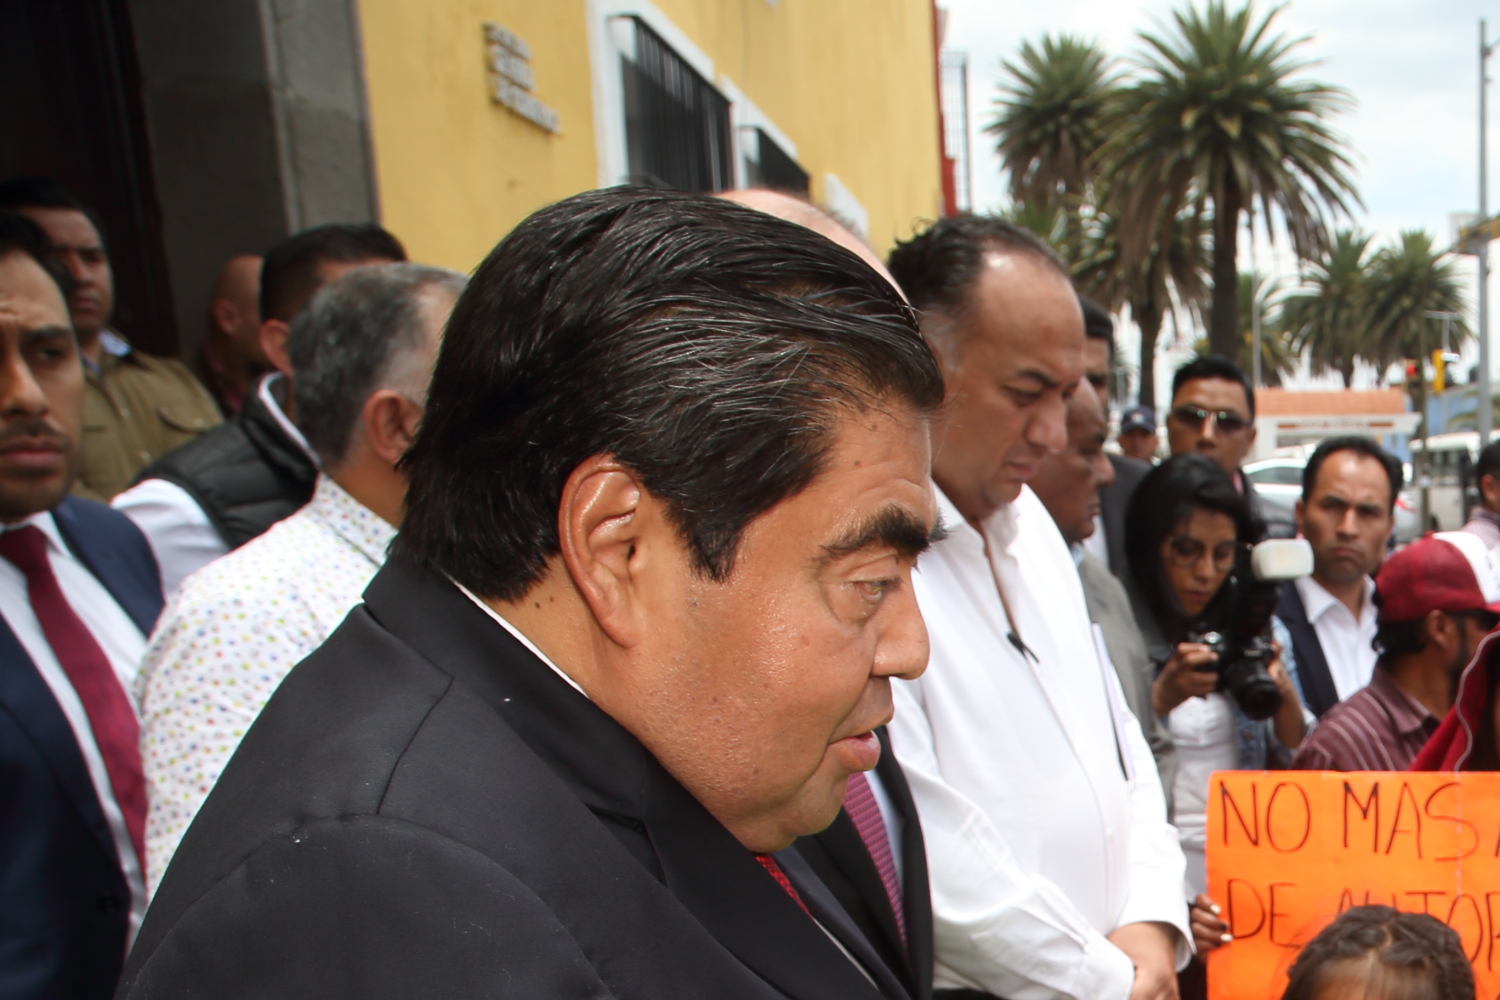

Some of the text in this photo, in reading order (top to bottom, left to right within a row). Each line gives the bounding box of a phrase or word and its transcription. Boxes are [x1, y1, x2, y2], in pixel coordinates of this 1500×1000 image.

[1219, 780, 1313, 853] NO
[1341, 781, 1480, 862] MAS
[1227, 878, 1302, 949] DE
